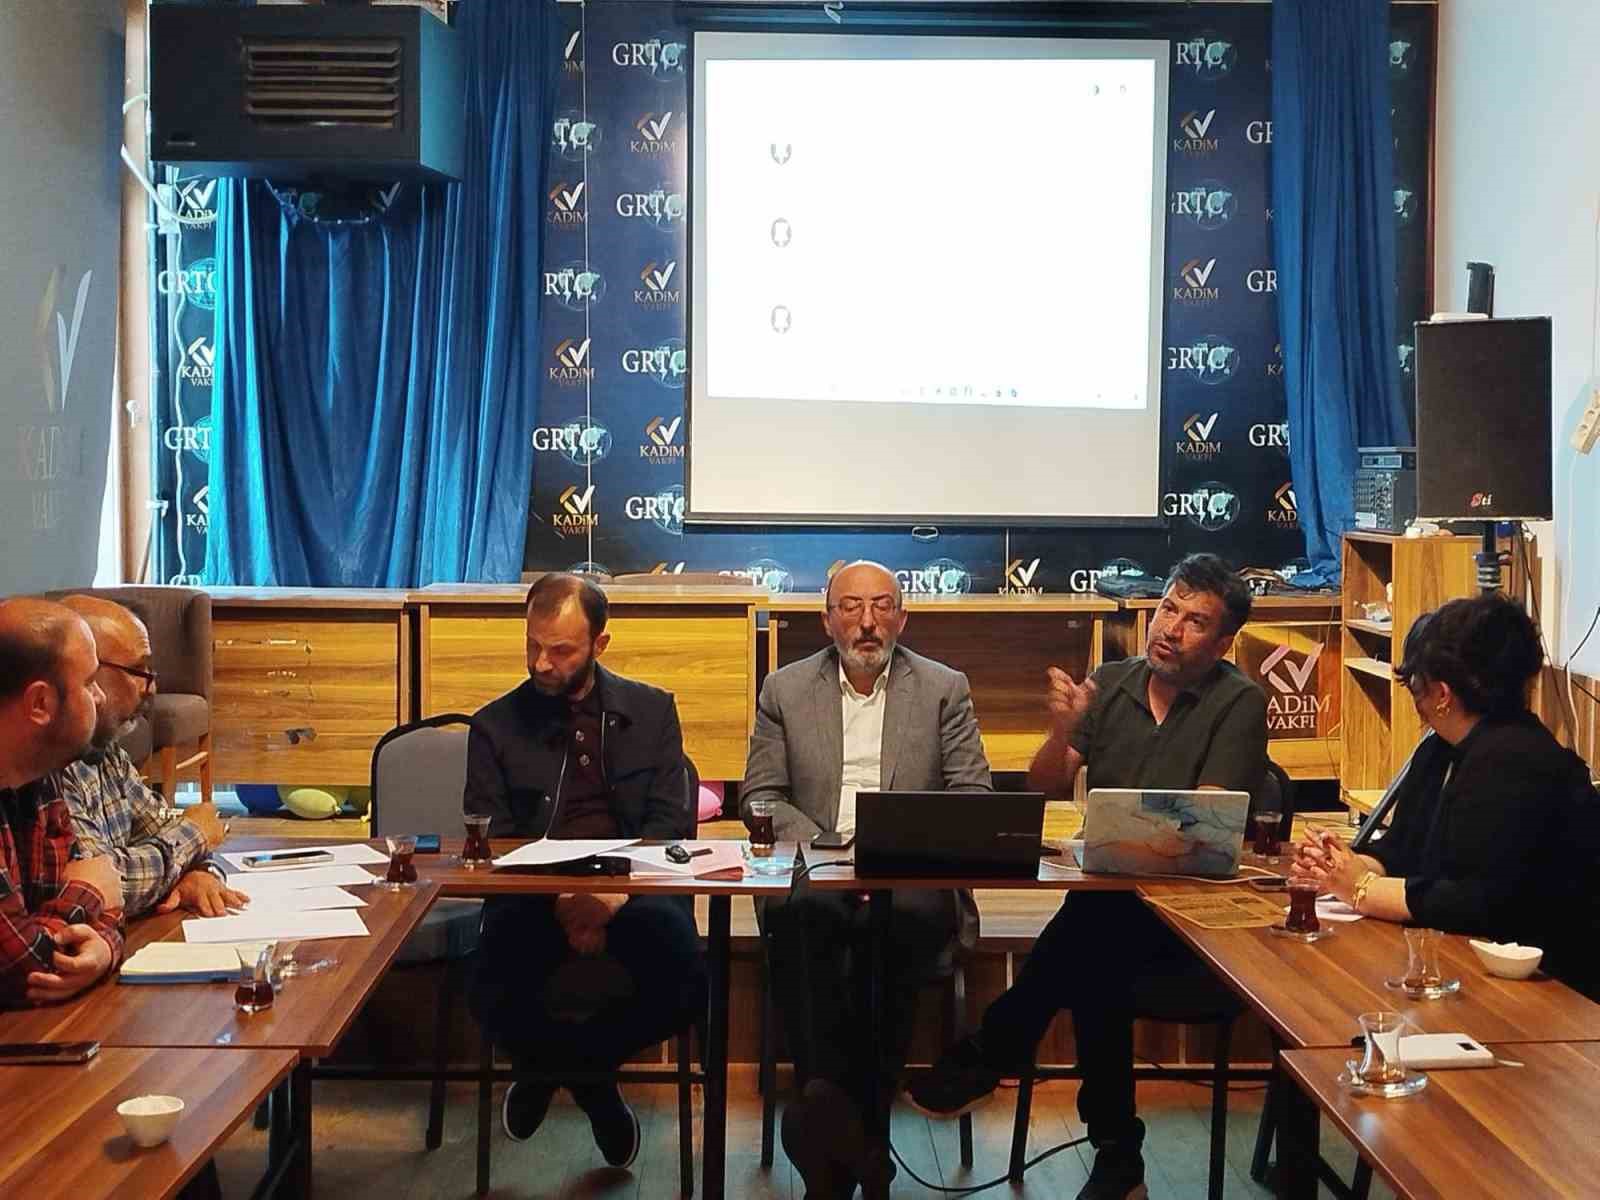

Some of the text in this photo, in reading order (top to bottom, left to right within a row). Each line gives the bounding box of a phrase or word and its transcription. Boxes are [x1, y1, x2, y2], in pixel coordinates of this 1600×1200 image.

[612, 43, 680, 66] GRTC
[1176, 42, 1223, 65] RTC
[616, 194, 682, 217] GRTC
[1171, 192, 1224, 215] RTC
[544, 272, 592, 295] RTC
[1247, 270, 1278, 292] GR
[622, 350, 687, 373] GRTC
[164, 427, 213, 450] GRT
[532, 428, 599, 450] GRTC
[1163, 493, 1226, 515] GRTC
[1268, 511, 1297, 521] KAD
[895, 570, 960, 593] GRTC
[1266, 695, 1332, 713] ADiM
[1266, 714, 1316, 729] VAKFI
